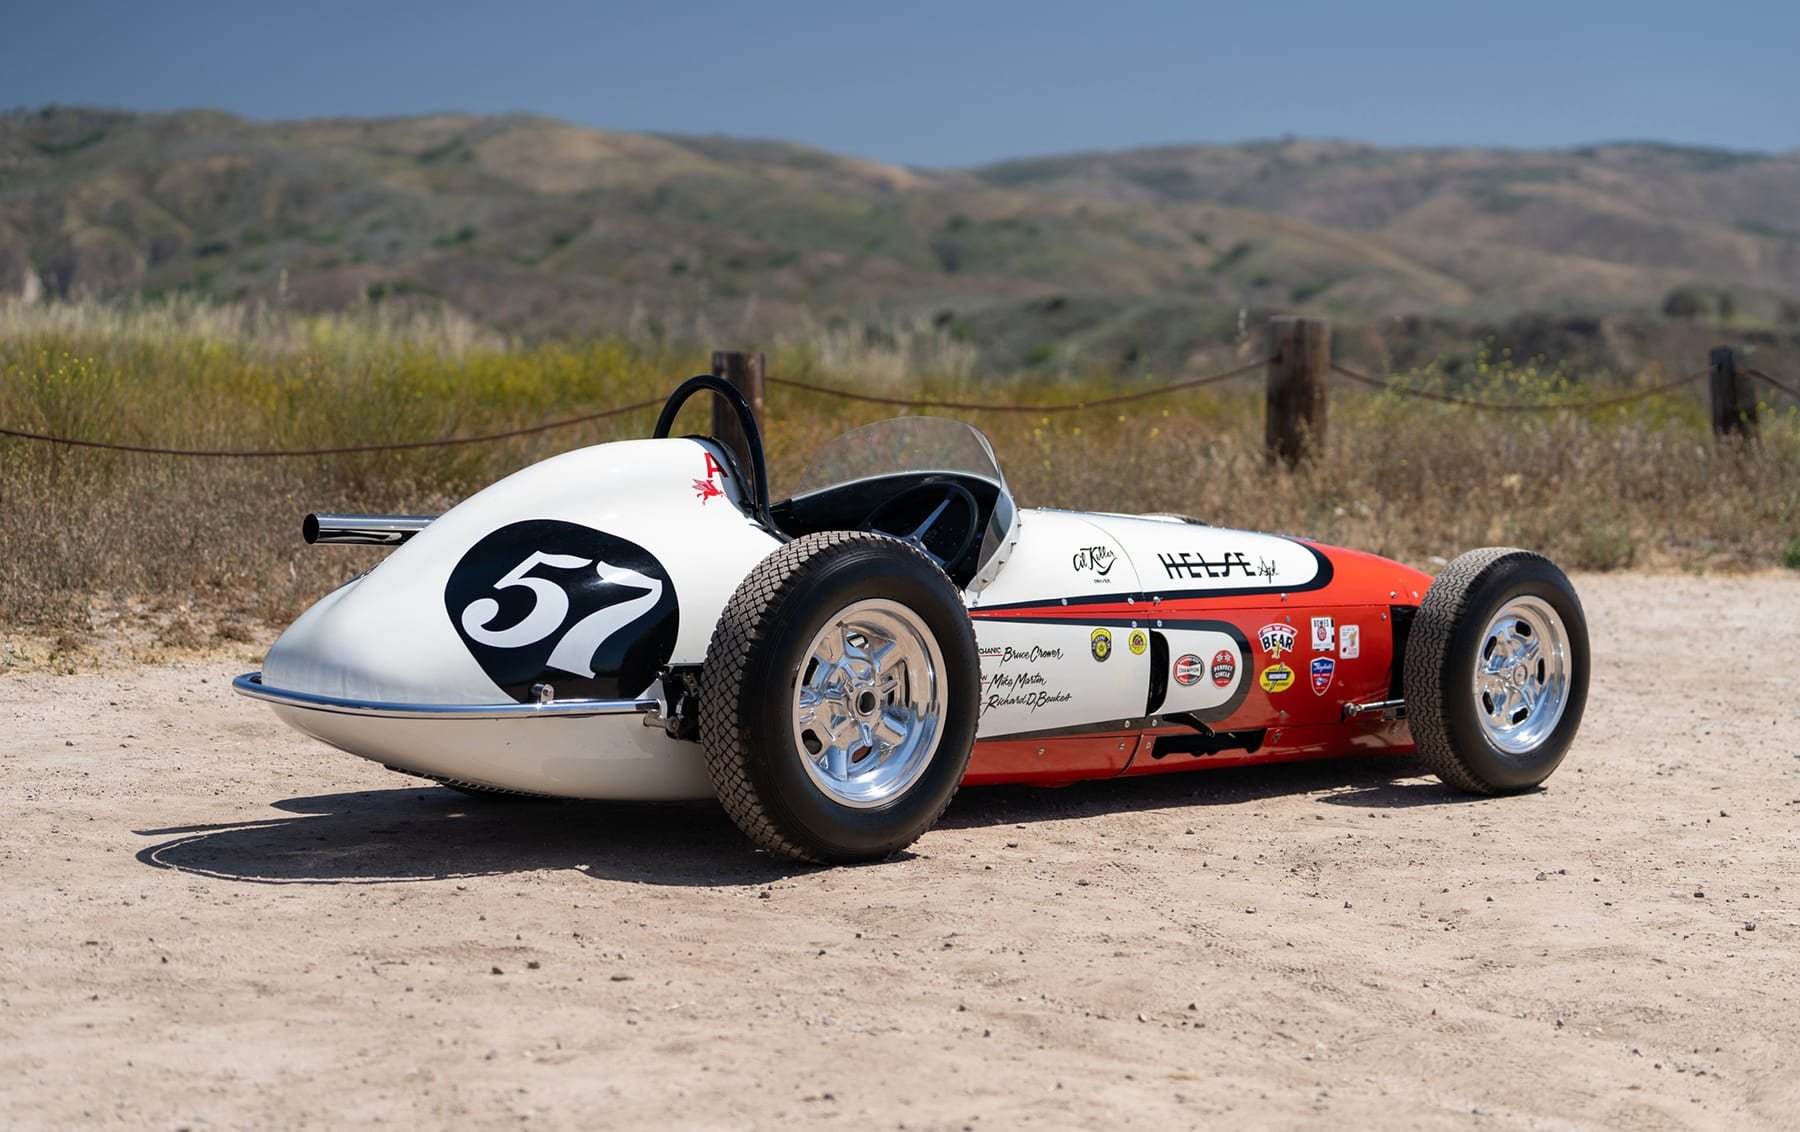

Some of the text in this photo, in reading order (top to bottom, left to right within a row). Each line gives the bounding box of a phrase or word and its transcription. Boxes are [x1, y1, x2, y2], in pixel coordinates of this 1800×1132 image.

[461, 550, 662, 679] 57
[1262, 633, 1293, 651] BEAR
[999, 646, 1030, 667] Bruce
[986, 672, 1047, 699] Mike Martin
